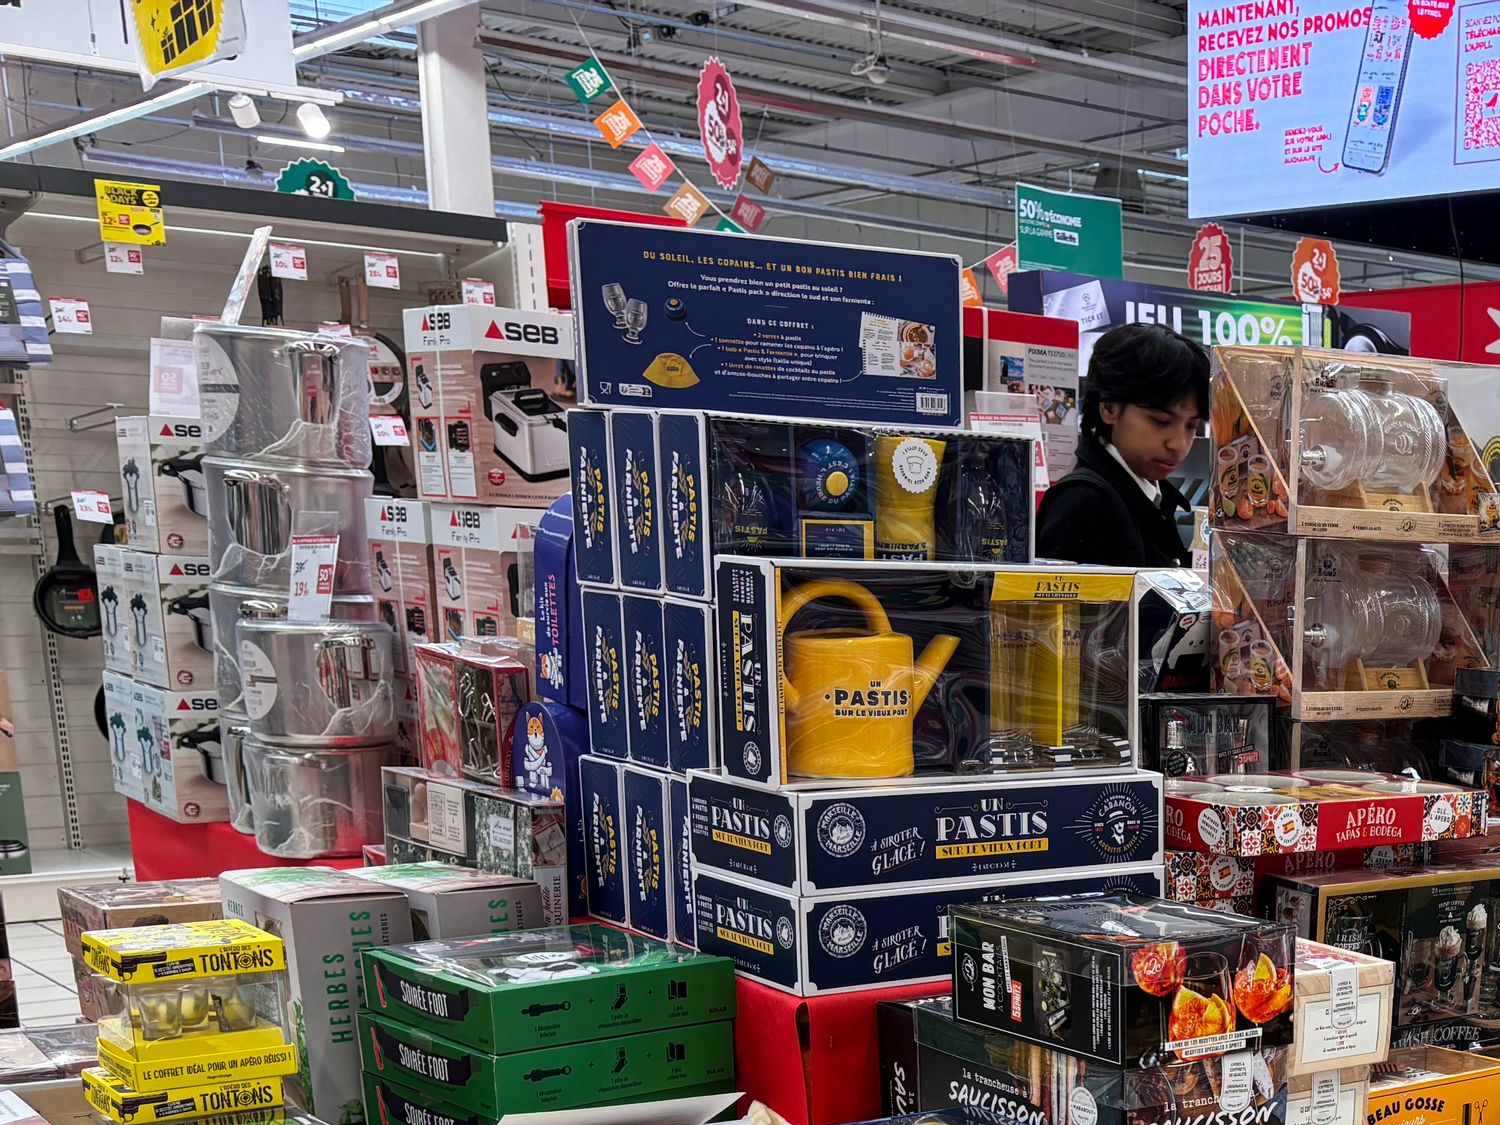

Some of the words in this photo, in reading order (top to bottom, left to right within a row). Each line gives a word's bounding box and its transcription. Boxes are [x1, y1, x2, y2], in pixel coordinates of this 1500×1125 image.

[1198, 30, 1266, 53] RECEVEZ
[1268, 19, 1299, 40] NOS
[1303, 7, 1372, 35] PROMOS
[1198, 42, 1312, 82] DIRECTEMENT
[1198, 81, 1243, 109] DANS
[1247, 72, 1303, 101] VOTRE
[1198, 236, 1221, 270] 25
[580, 446, 592, 549] FARNIENTE
[625, 448, 639, 554] FARNIENTE
[671, 450, 683, 560] FARNIENTE
[595, 625, 607, 724] FARNIENTE
[634, 629, 648, 732] FARNIENTE
[834, 689, 908, 706] PASTIS
[711, 804, 771, 840] PASTIS
[980, 798, 1004, 812] UN
[1346, 803, 1396, 829] APÉRO
[935, 810, 1048, 842] PASTIS
[1335, 827, 1361, 843] TAPAS
[1369, 824, 1402, 840] BODEGA
[715, 904, 773, 940] PASTIS
[400, 980, 428, 1012] SOIRÉE
[428, 987, 449, 1018] FOOT
[143, 1071, 152, 1081] LE
[153, 1067, 184, 1079] COFFRET
[186, 1063, 205, 1075] IDÉAL
[208, 1063, 227, 1073] POUR
[229, 1060, 238, 1069] UN
[240, 1056, 262, 1068] APÉRO
[399, 1043, 428, 1076] SOIRÉE
[428, 1050, 450, 1082] FOOT
[1406, 1097, 1446, 1113] GOSSE
